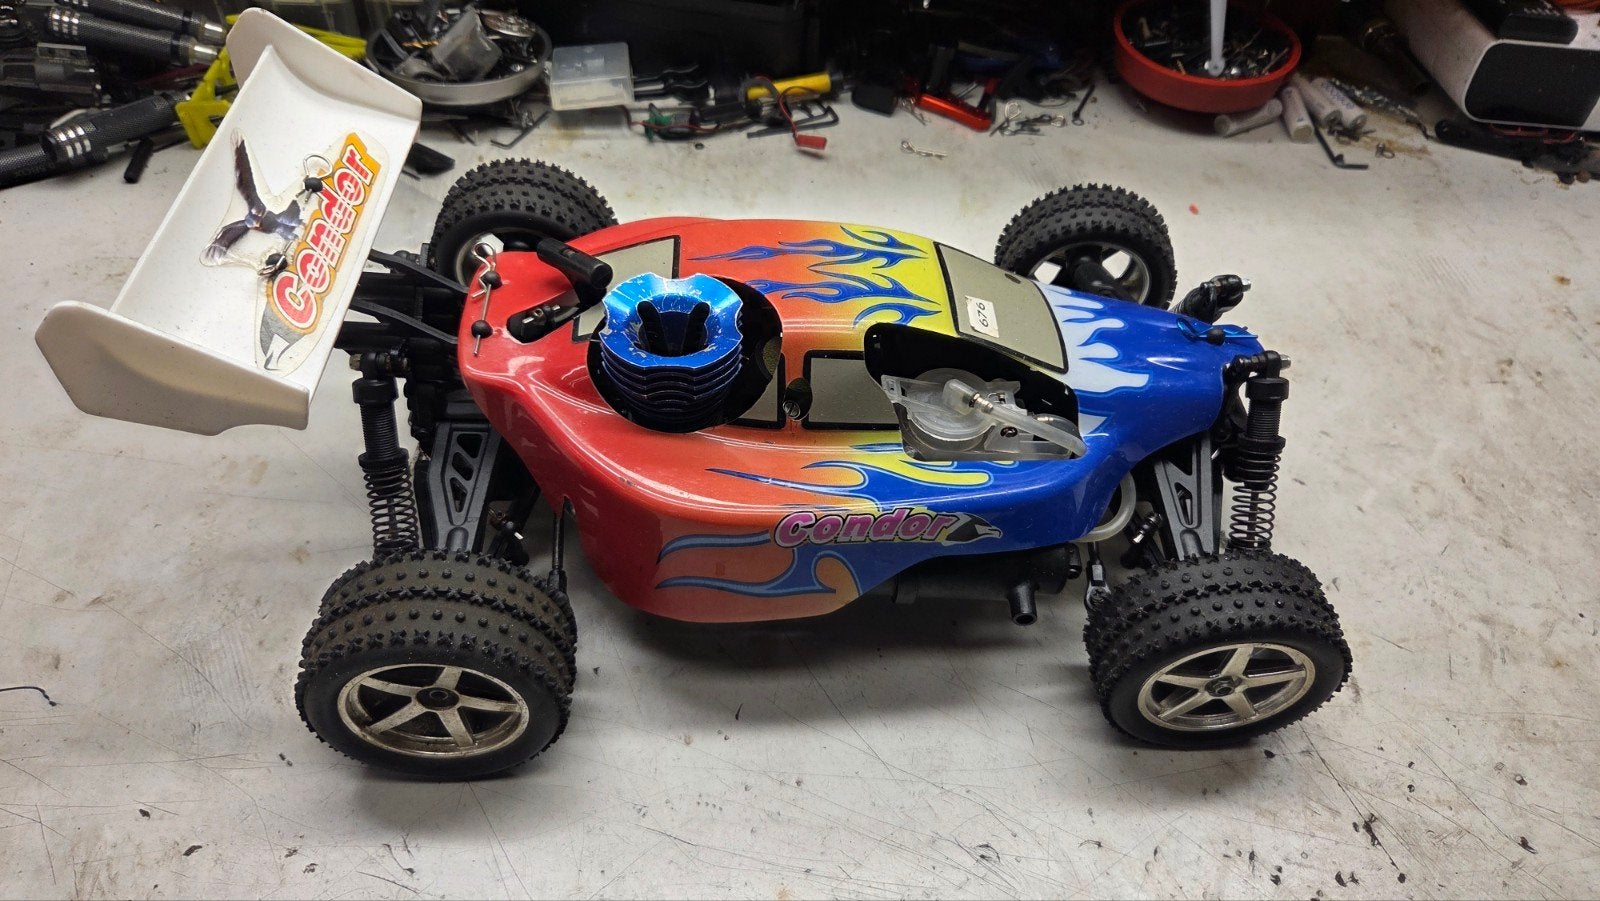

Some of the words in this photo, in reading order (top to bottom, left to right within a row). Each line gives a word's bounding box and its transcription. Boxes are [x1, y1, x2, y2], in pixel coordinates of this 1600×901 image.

[274, 145, 375, 328] Condor
[976, 302, 989, 327] 676
[775, 508, 957, 547] Condor
